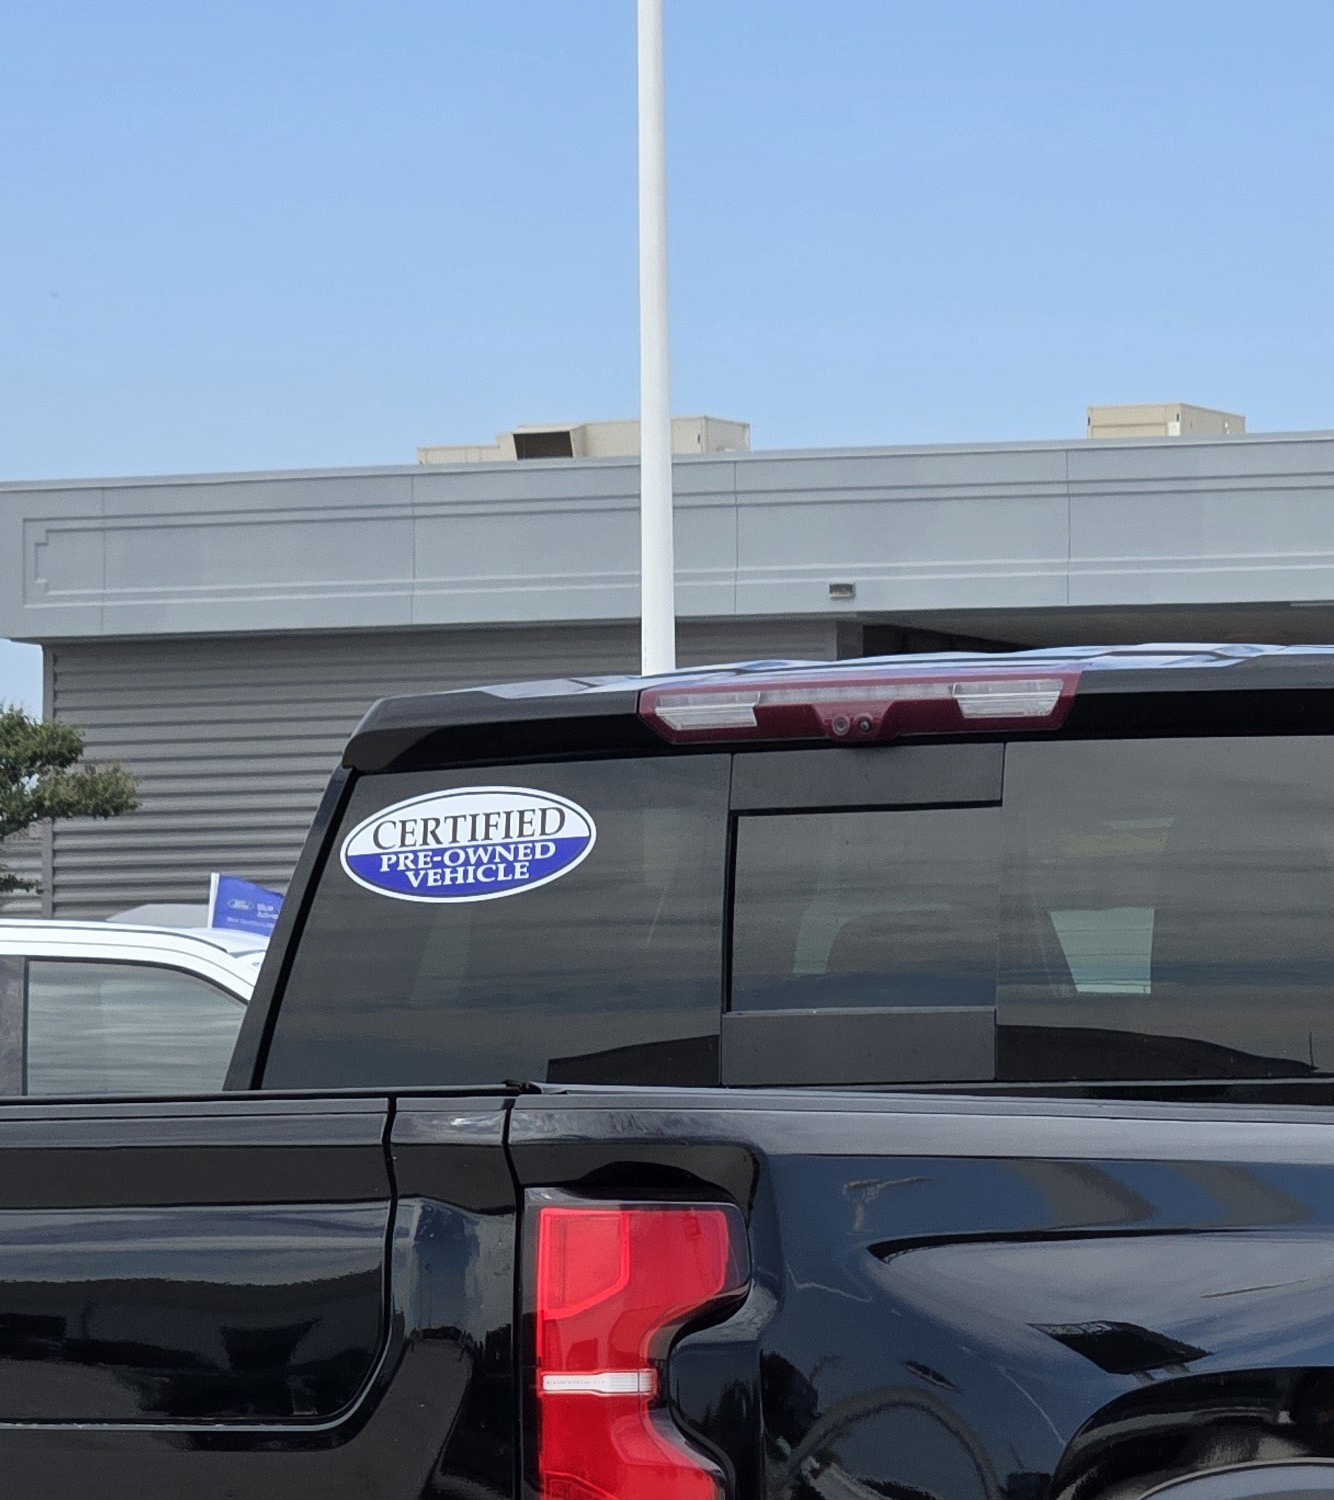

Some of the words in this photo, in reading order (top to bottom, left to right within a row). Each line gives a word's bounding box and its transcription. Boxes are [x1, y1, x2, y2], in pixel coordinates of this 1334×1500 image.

[372, 806, 565, 851] CERTIFIED
[379, 841, 556, 872] PRE-OWNED
[405, 862, 530, 888] VEHICLE
